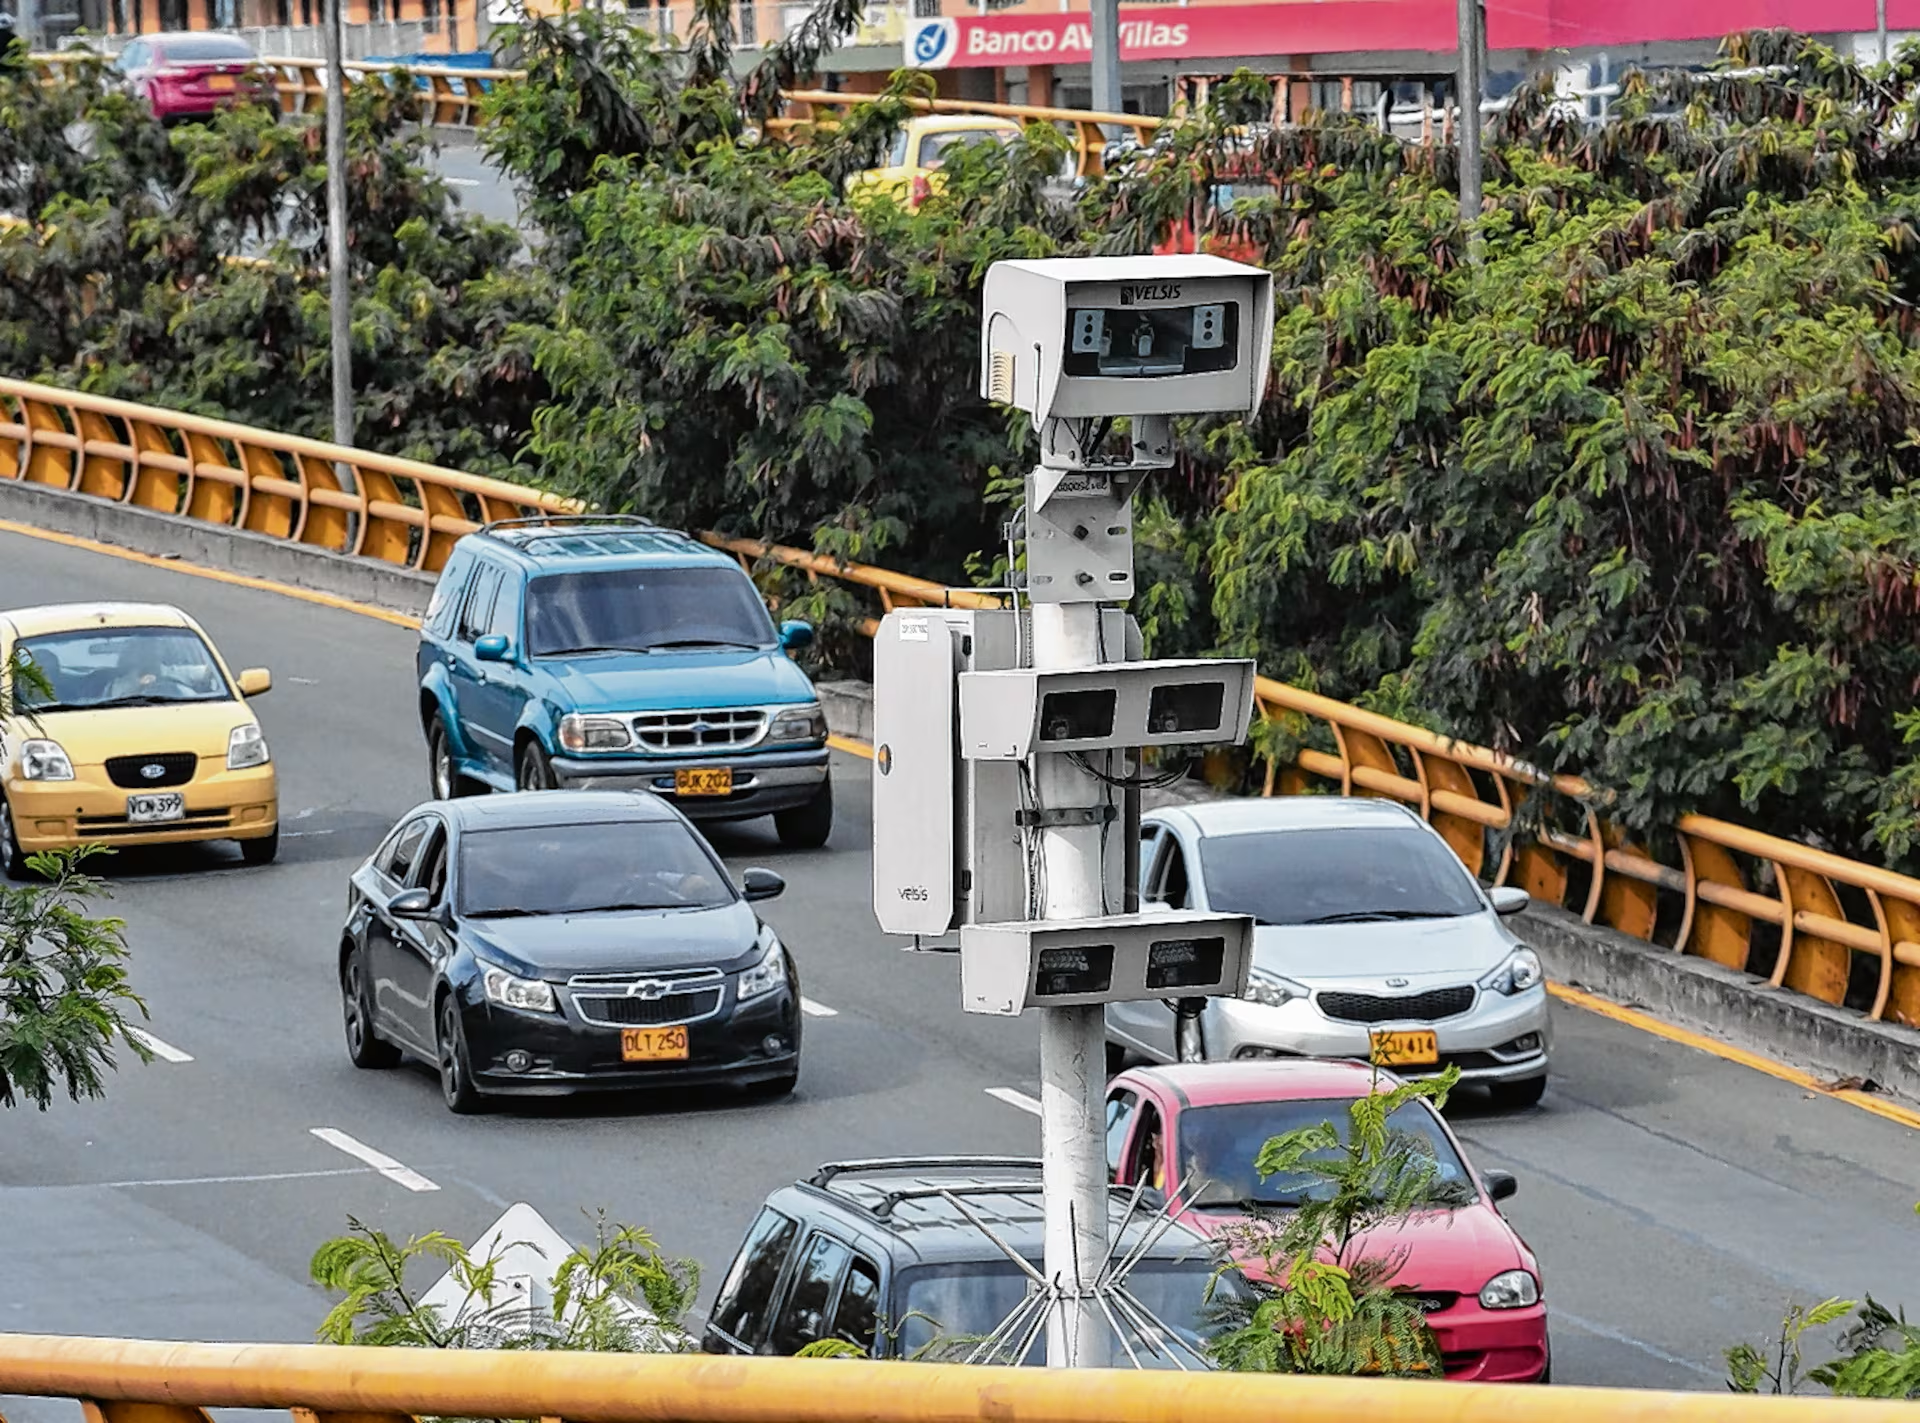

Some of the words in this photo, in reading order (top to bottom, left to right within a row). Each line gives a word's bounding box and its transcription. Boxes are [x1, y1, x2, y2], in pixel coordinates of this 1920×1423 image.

[967, 27, 1055, 54] Banco
[1119, 21, 1189, 48] illas
[1135, 284, 1181, 300] VELSIS
[706, 773, 730, 788] 202
[157, 797, 182, 812] 399
[625, 1032, 652, 1052] DLT
[657, 1030, 686, 1051] 250
